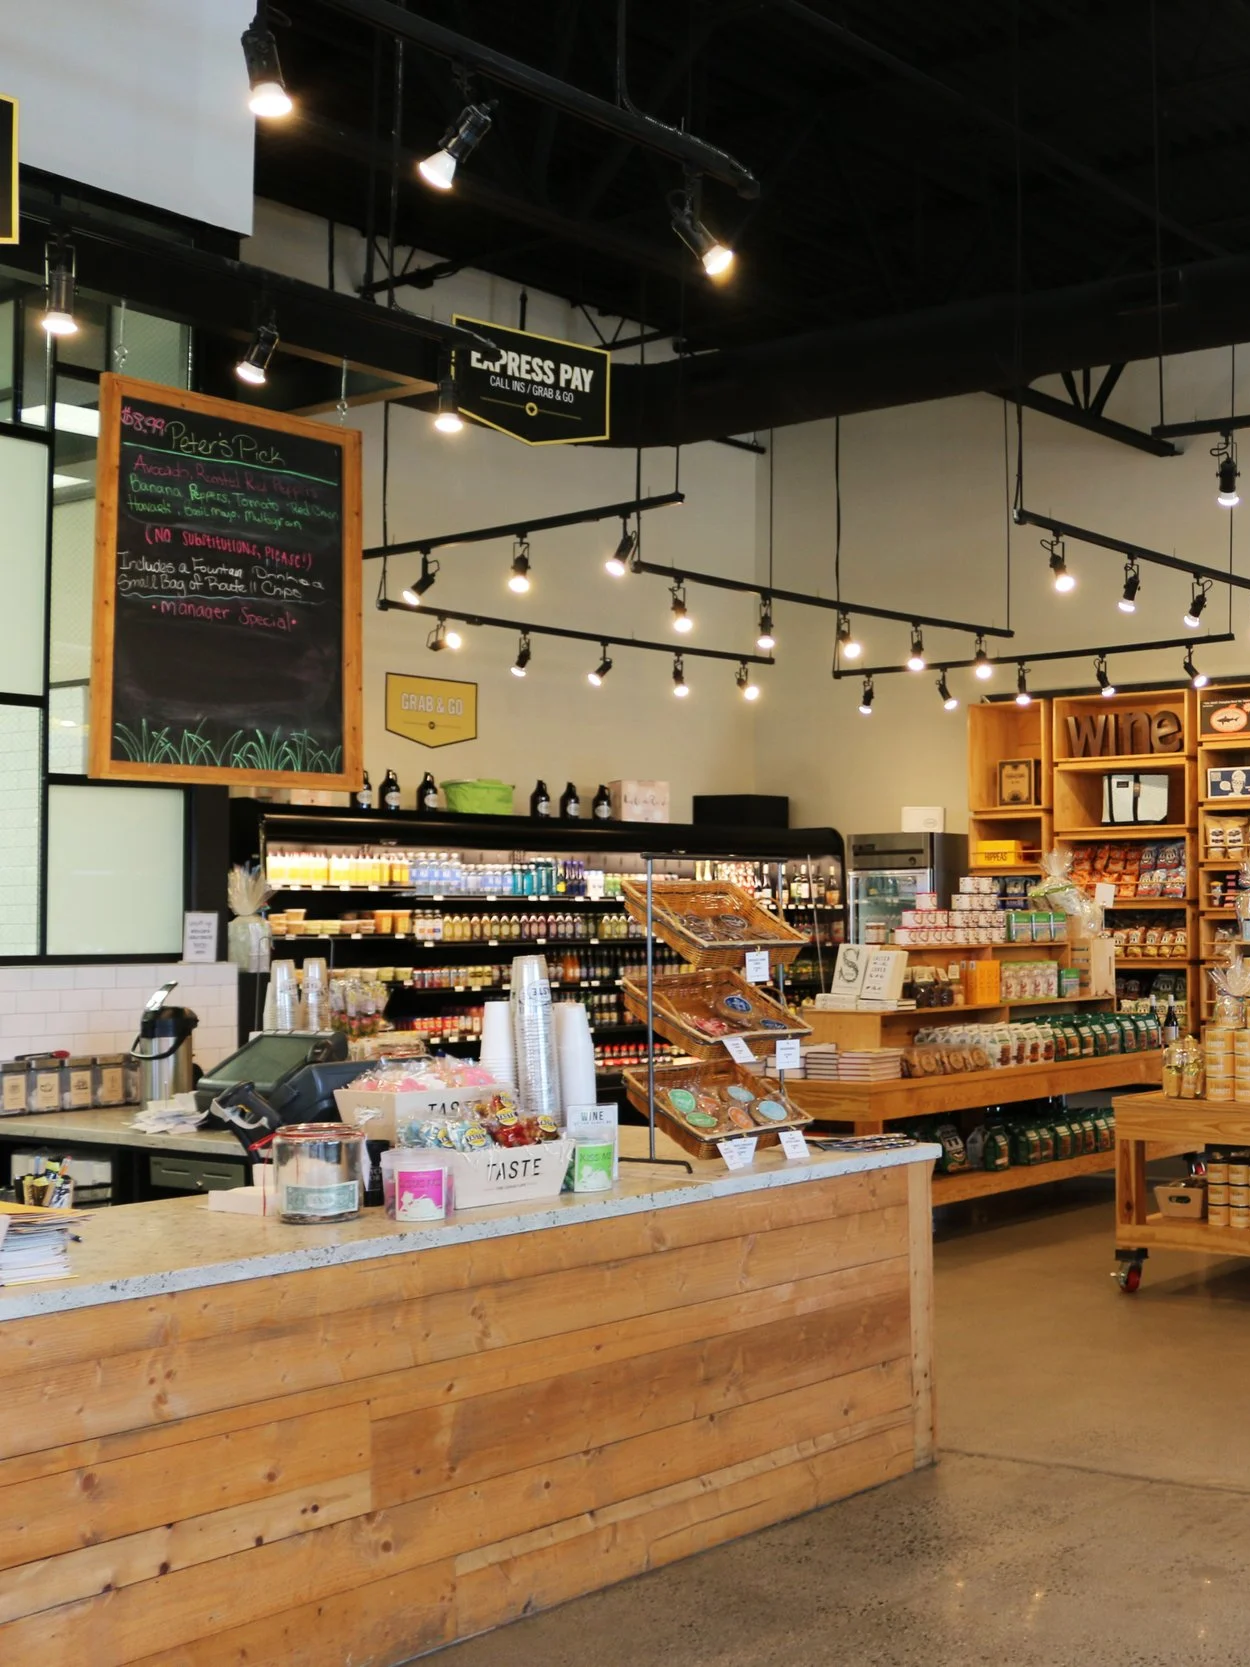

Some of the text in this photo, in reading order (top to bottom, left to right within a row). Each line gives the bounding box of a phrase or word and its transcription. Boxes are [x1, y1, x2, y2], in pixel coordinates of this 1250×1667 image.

[490, 375, 510, 390] CALL
[512, 380, 526, 393] INS
[532, 385, 554, 399] GRAB
[555, 389, 562, 401] &
[562, 390, 574, 404] GO
[559, 363, 594, 393] PAY
[232, 434, 286, 466] Pick
[129, 472, 183, 498] Banana
[117, 551, 175, 574] Includes
[179, 563, 190, 574] a
[118, 574, 157, 591] Small
[160, 574, 186, 597] Bag
[189, 575, 204, 591] of
[401, 693, 434, 712] GRAB
[448, 698, 464, 716] GO
[1067, 710, 1184, 758] wine
[984, 851, 1008, 862] HIPPEAS
[428, 1101, 460, 1115] TAS
[581, 1111, 604, 1121] WINE
[487, 1158, 542, 1181] TASTE
